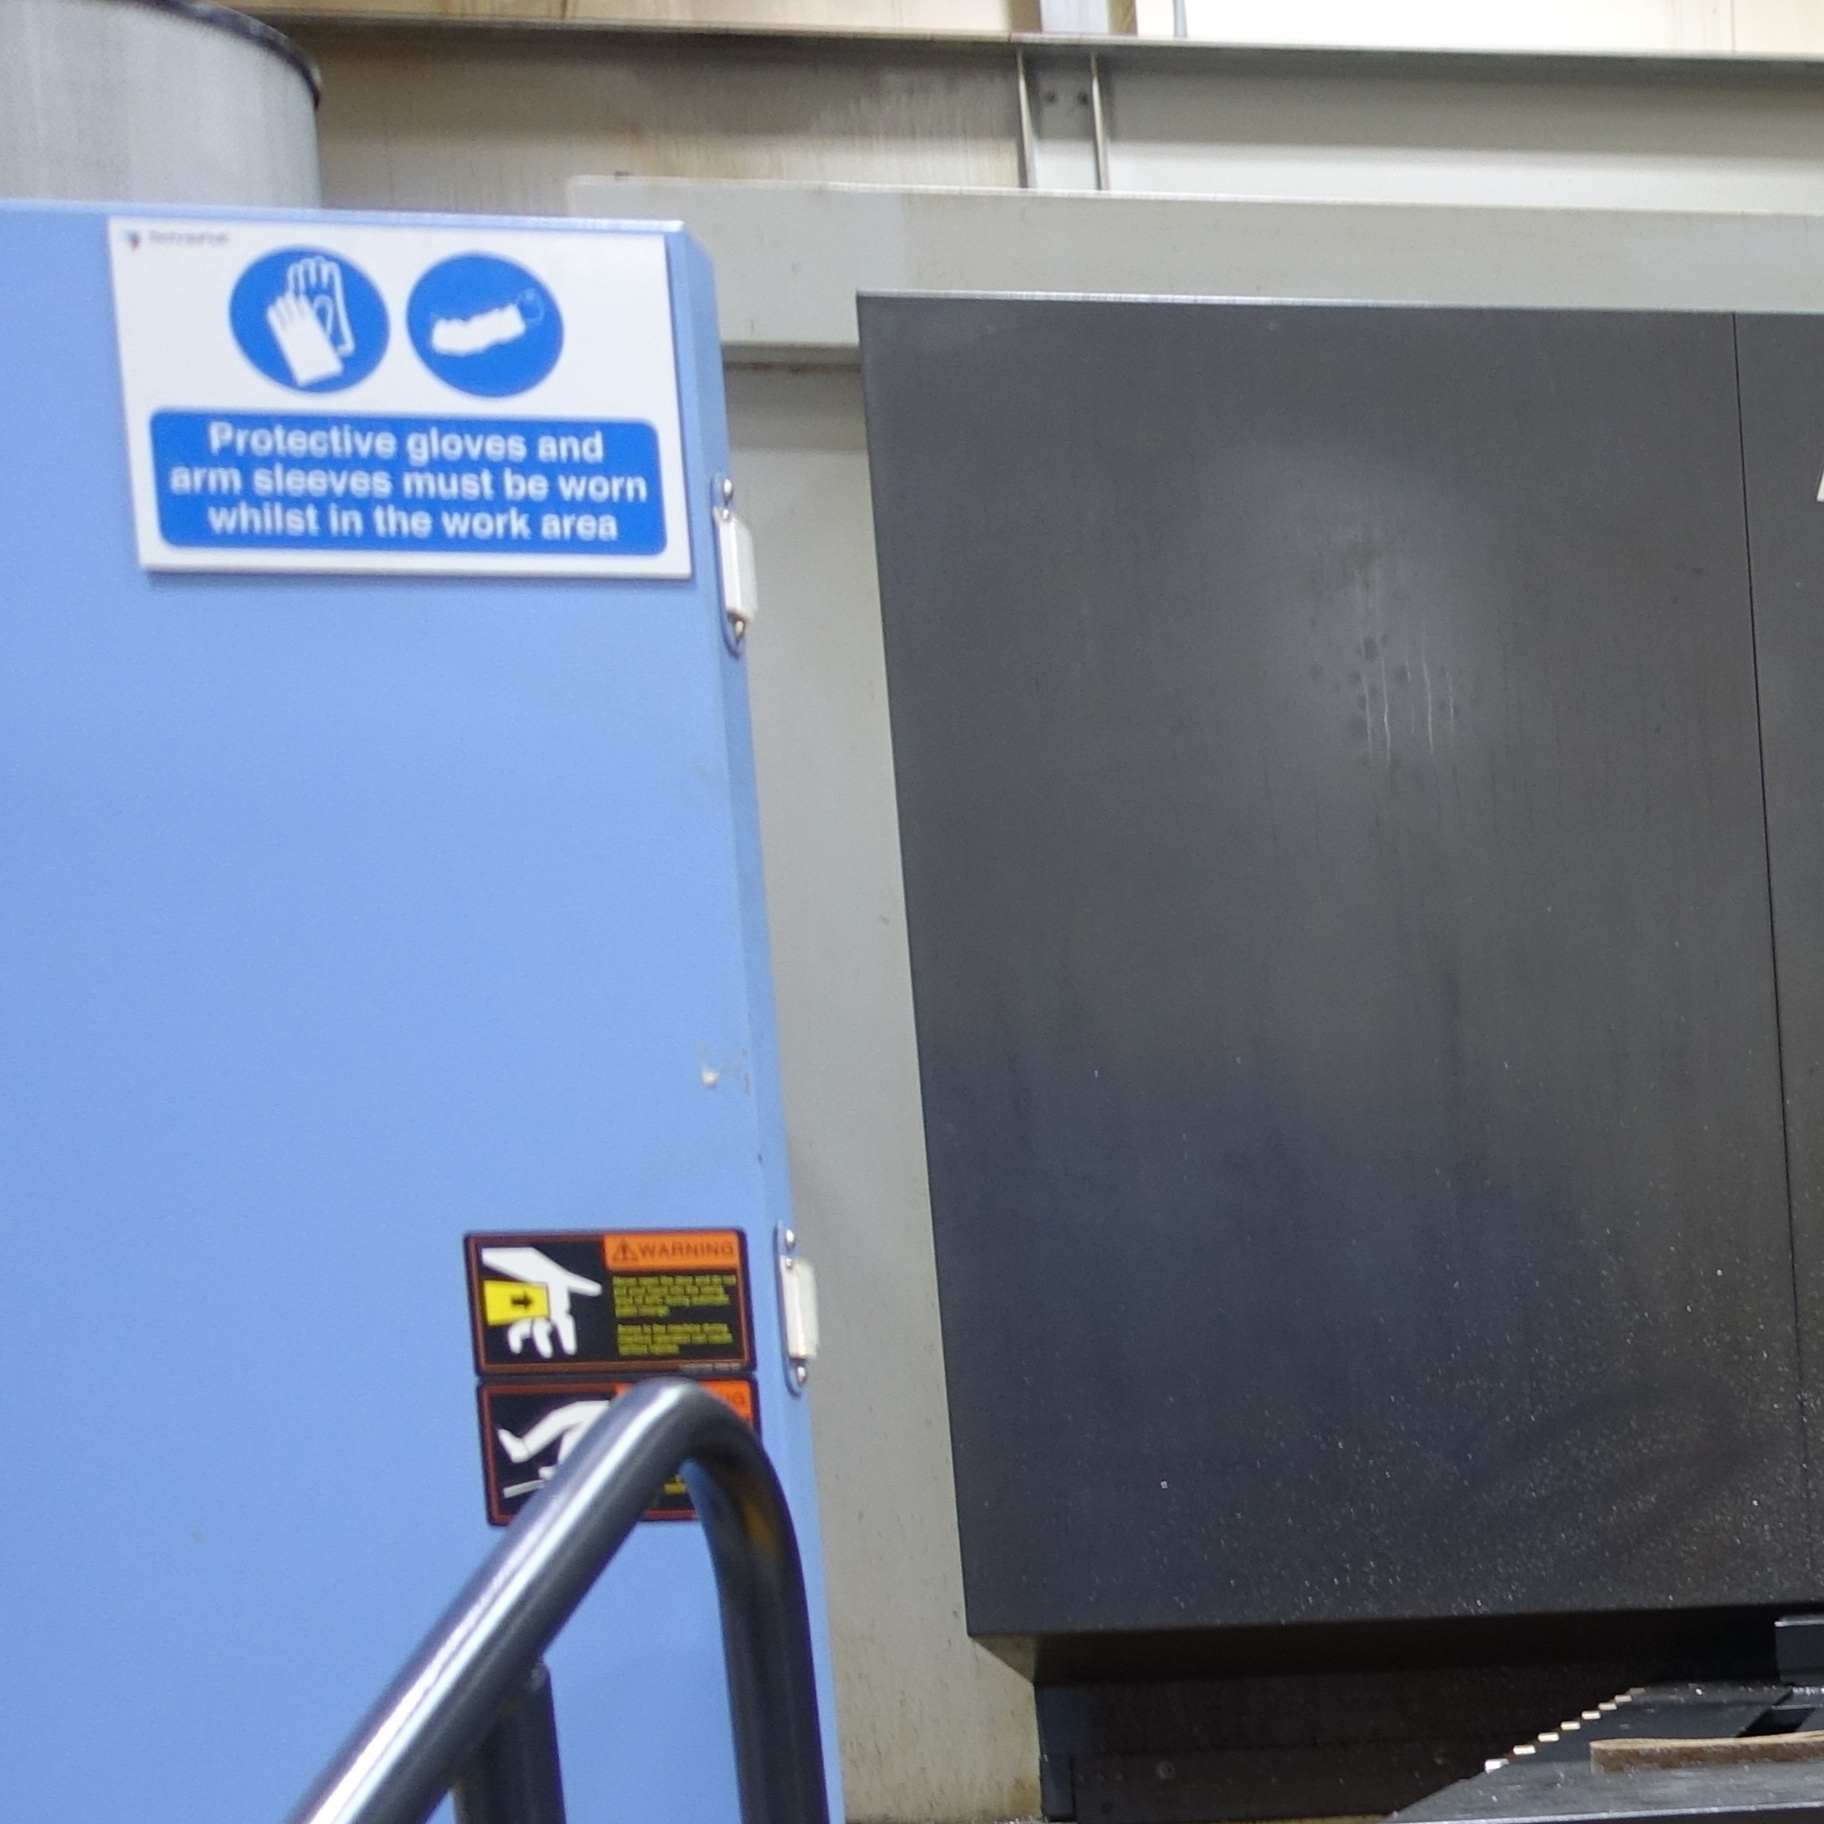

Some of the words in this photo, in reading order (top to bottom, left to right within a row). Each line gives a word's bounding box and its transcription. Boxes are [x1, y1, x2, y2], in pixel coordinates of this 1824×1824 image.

[208, 420, 398, 459] Protective
[406, 426, 527, 467] gloves
[537, 430, 604, 463] and
[170, 466, 243, 495] arm
[253, 462, 393, 498] sleeves
[403, 468, 494, 501] must
[504, 467, 549, 502] be
[558, 474, 648, 503] worn
[207, 501, 320, 537] whilst
[328, 502, 364, 538] in
[373, 504, 433, 539] the
[441, 507, 532, 540] work
[541, 513, 619, 541] area
[639, 1242, 735, 1259] WARNING
